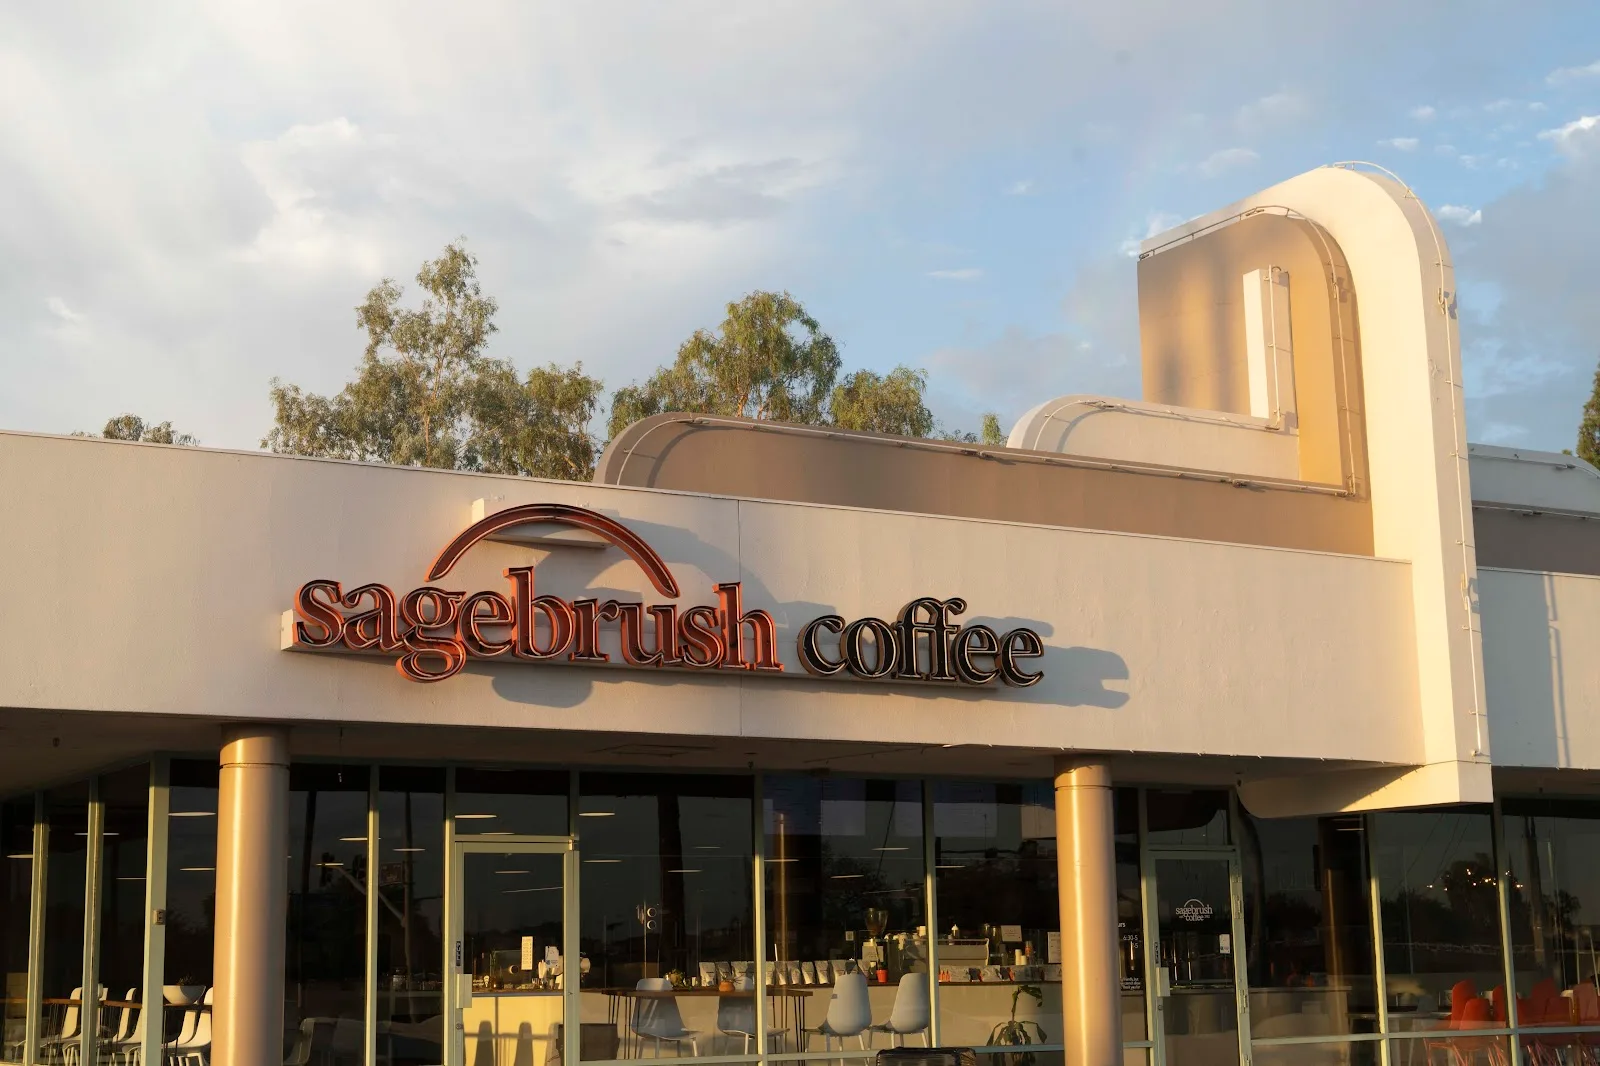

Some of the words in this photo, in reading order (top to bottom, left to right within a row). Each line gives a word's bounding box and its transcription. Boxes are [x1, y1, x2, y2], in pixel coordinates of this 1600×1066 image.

[294, 567, 784, 683] sagebrush
[798, 597, 1044, 688] coffee
[1175, 904, 1213, 917] sagebrush
[1185, 914, 1205, 922] coffee
